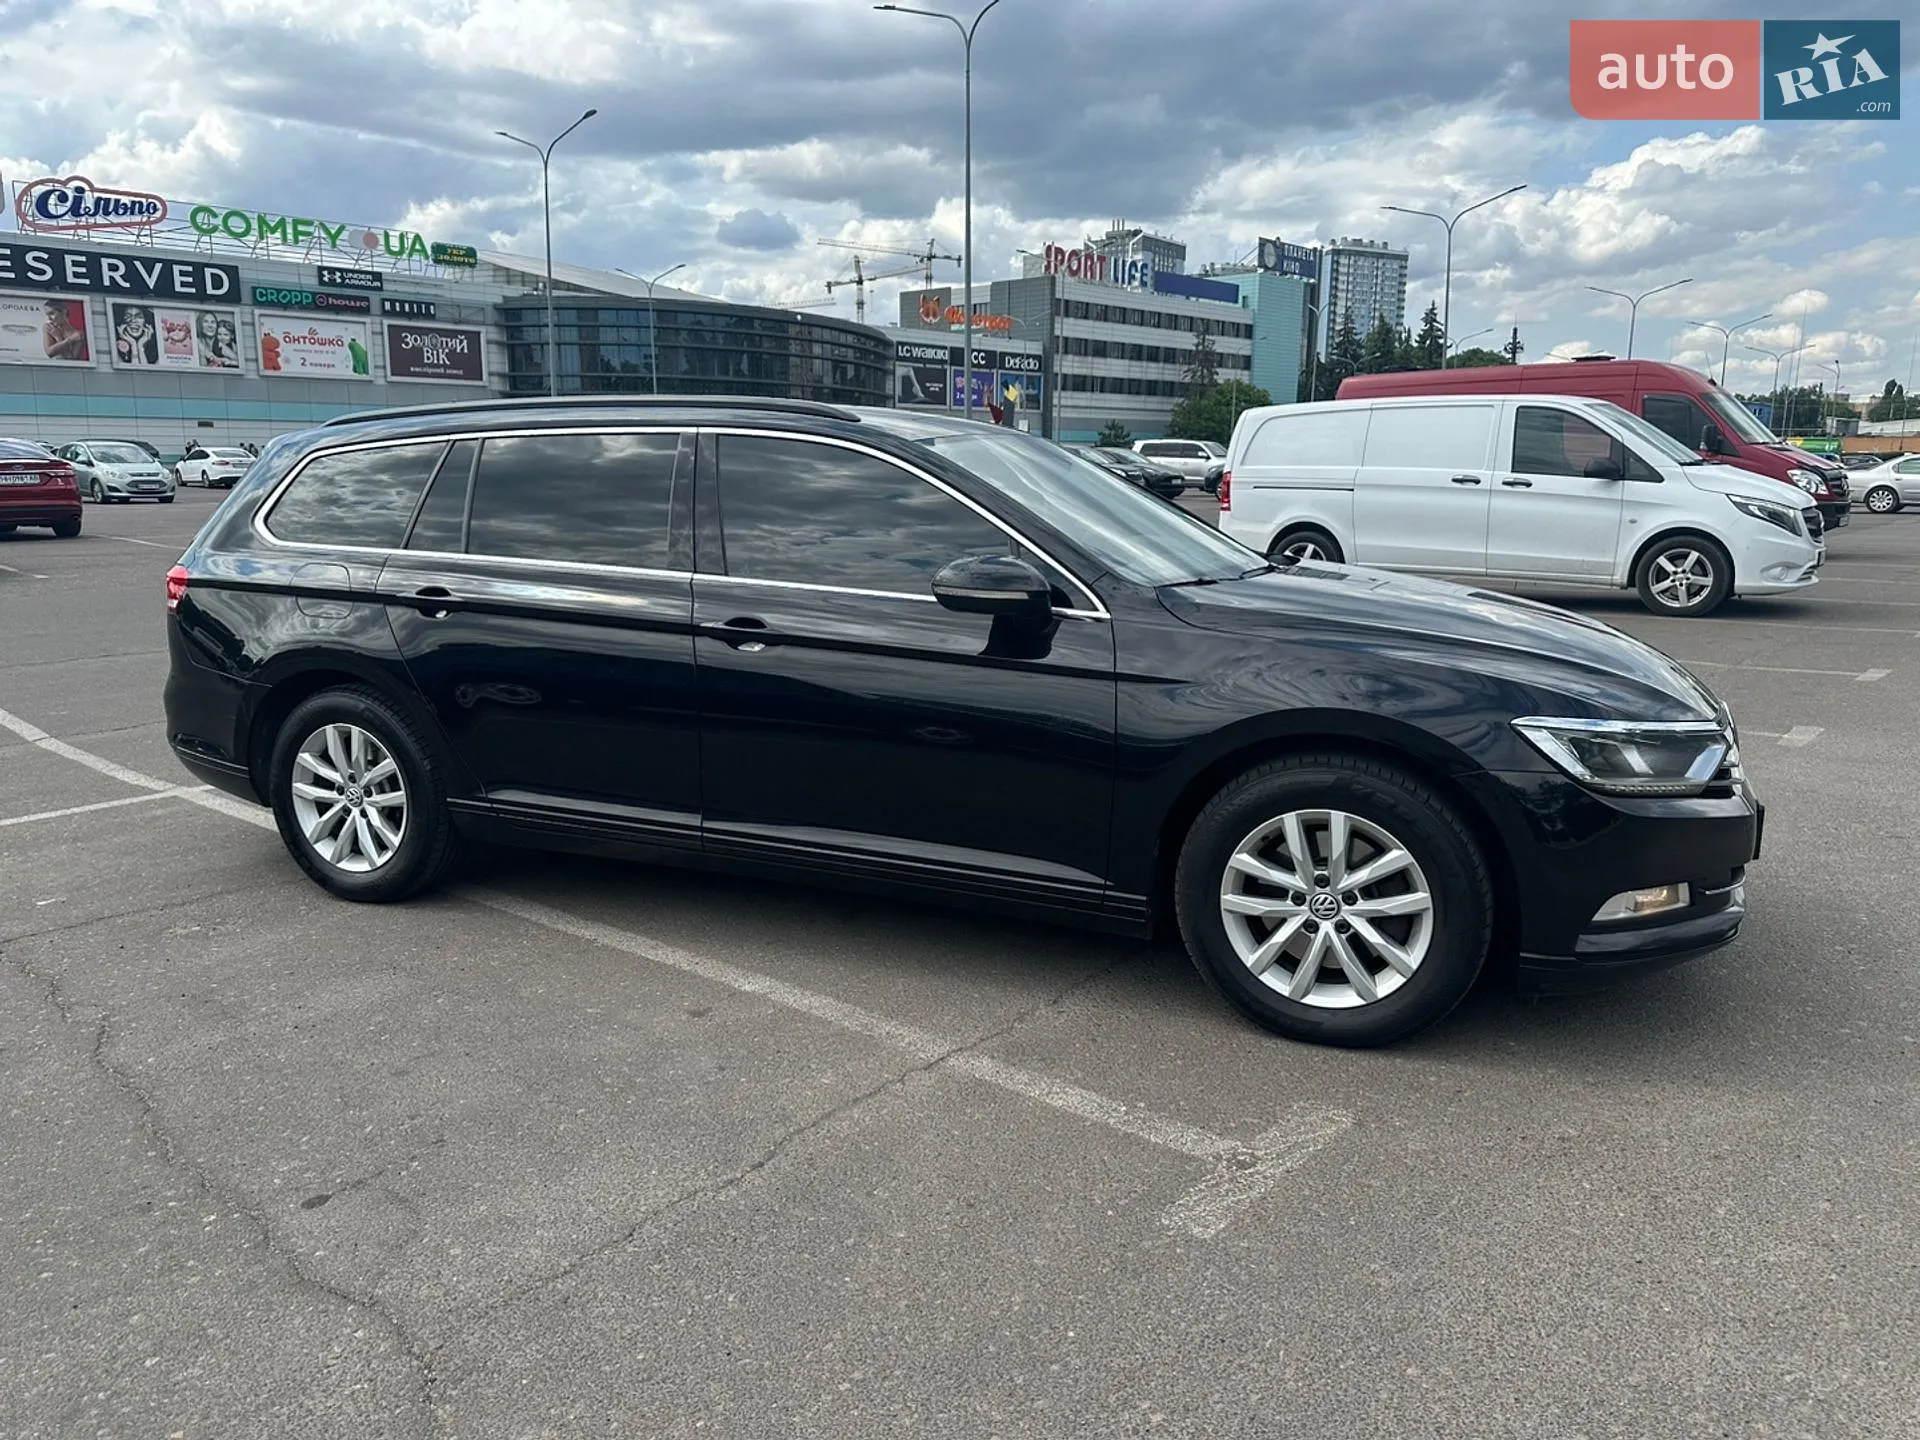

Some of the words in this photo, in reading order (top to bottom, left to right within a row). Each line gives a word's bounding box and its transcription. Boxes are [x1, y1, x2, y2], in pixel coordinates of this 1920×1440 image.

[35, 185, 159, 219] Сільпо
[190, 205, 346, 249] COMFY
[1043, 244, 1106, 281] SPORT
[1111, 256, 1149, 288] LIFE
[343, 271, 373, 280] UNDER
[344, 278, 382, 288] ARMOUR
[255, 287, 313, 306] CROPP
[898, 345, 911, 358] LC
[970, 352, 986, 364] CC
[300, 356, 308, 367] 2
